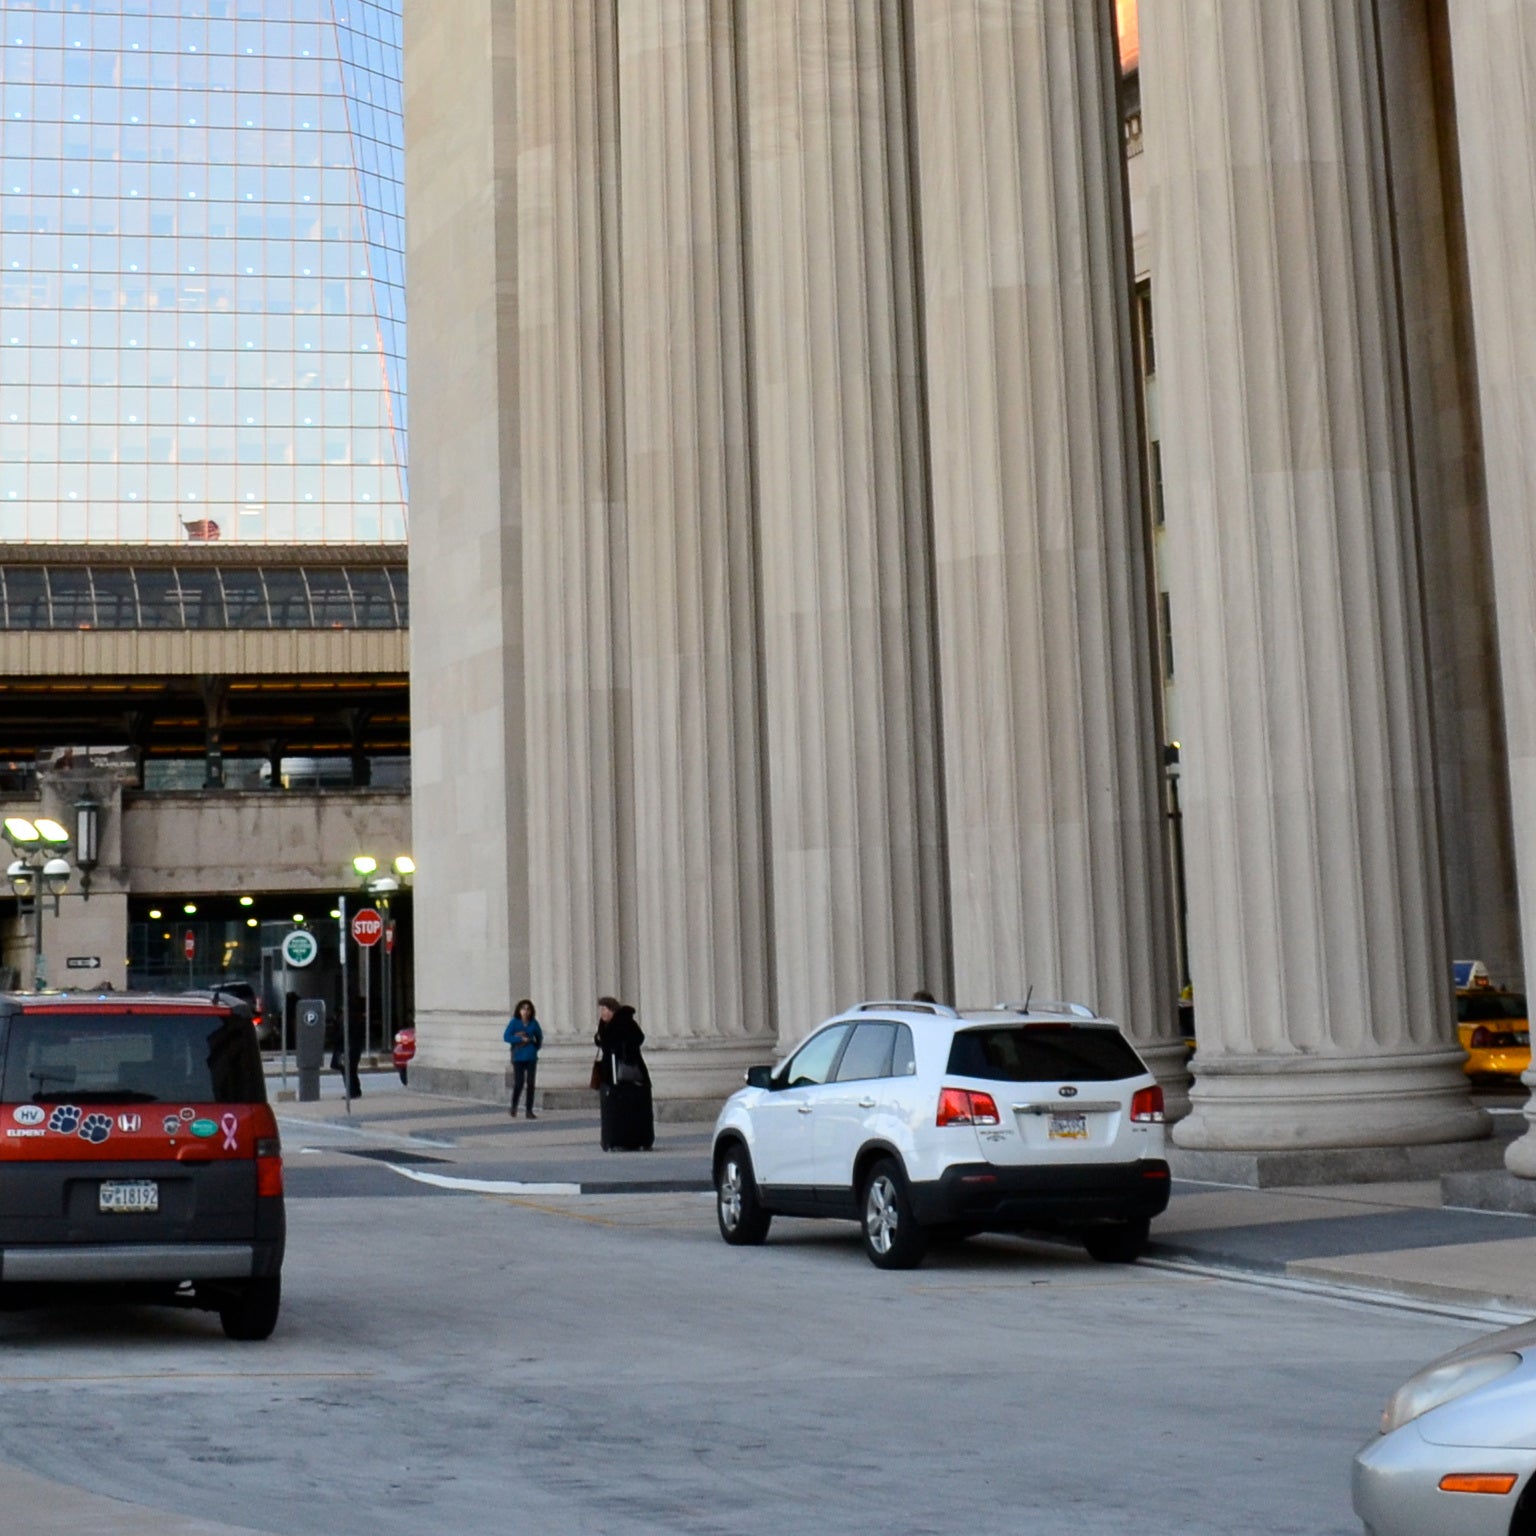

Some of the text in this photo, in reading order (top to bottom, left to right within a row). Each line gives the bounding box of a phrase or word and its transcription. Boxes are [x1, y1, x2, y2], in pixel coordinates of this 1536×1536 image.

[355, 921, 381, 934] STOP
[21, 1110, 38, 1120] HV
[6, 1129, 46, 1137] ELEMENT
[123, 1187, 156, 1204] 18192
